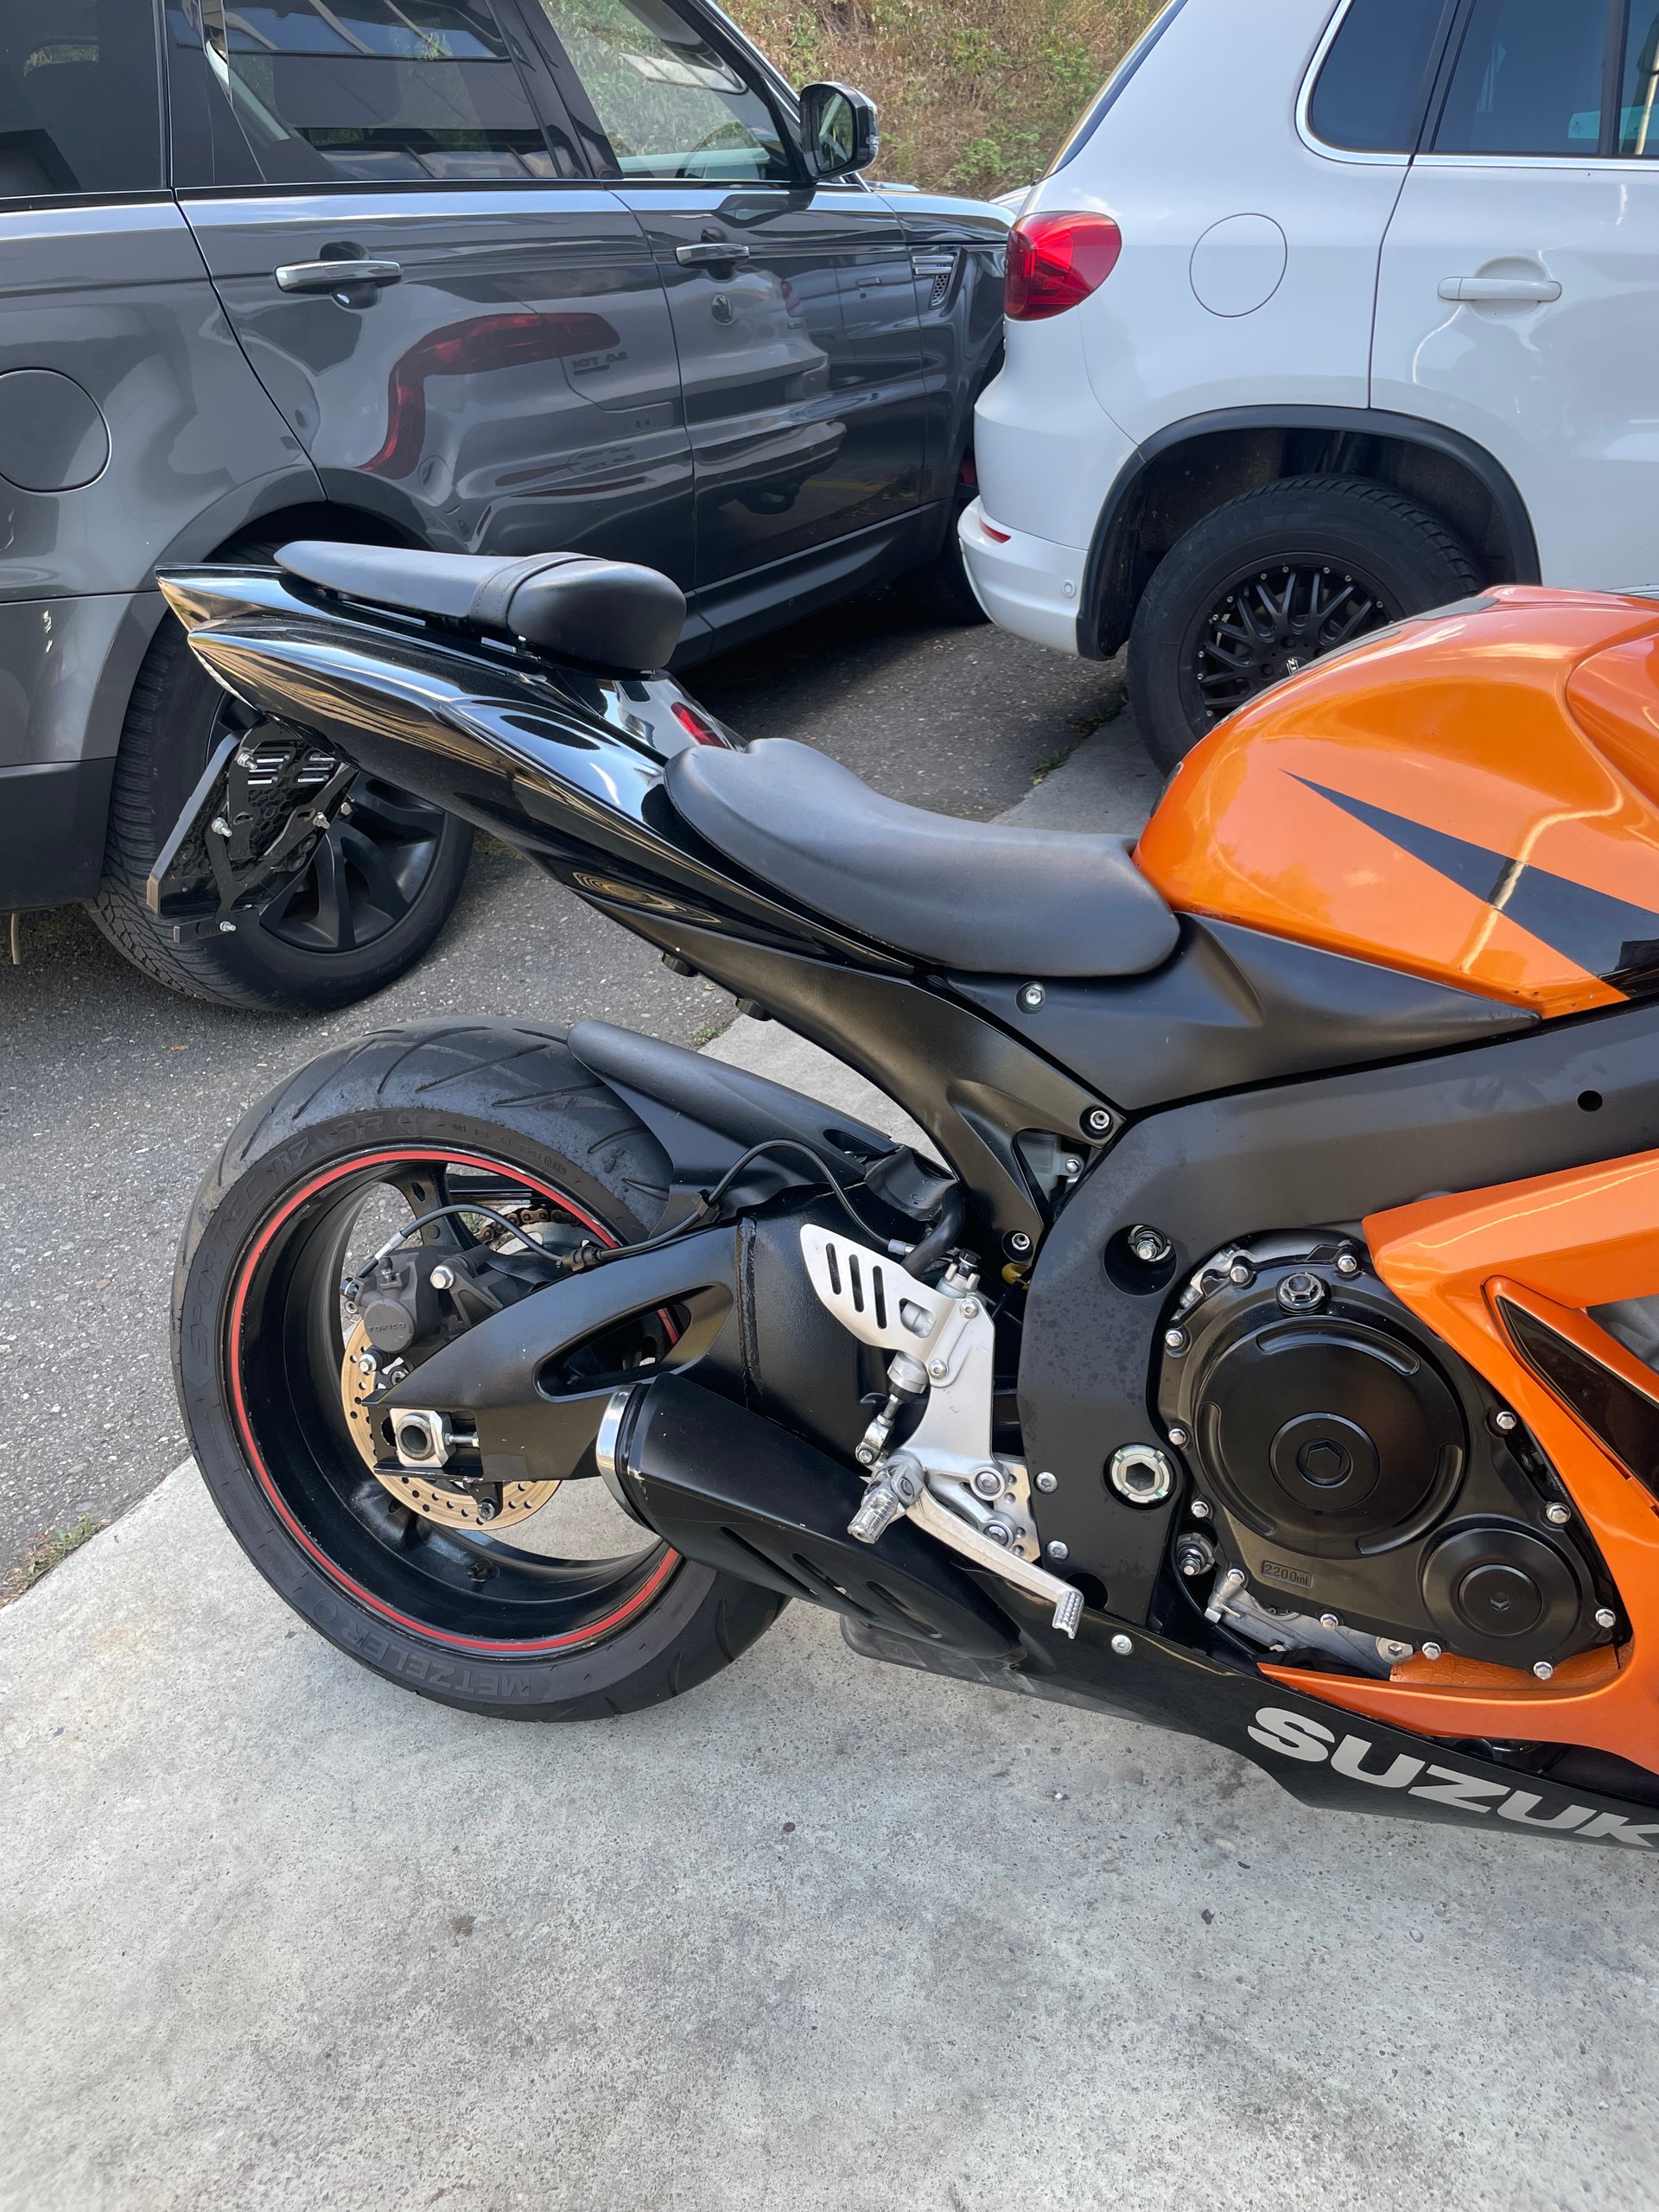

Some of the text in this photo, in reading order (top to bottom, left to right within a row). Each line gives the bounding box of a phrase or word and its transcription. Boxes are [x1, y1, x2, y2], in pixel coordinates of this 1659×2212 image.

[189, 1173, 264, 1367] SPORTEC
[366, 1321, 406, 1333] TOKICO
[1264, 1563, 1309, 1586] 2200ml
[341, 1618, 531, 1697] METZELER
